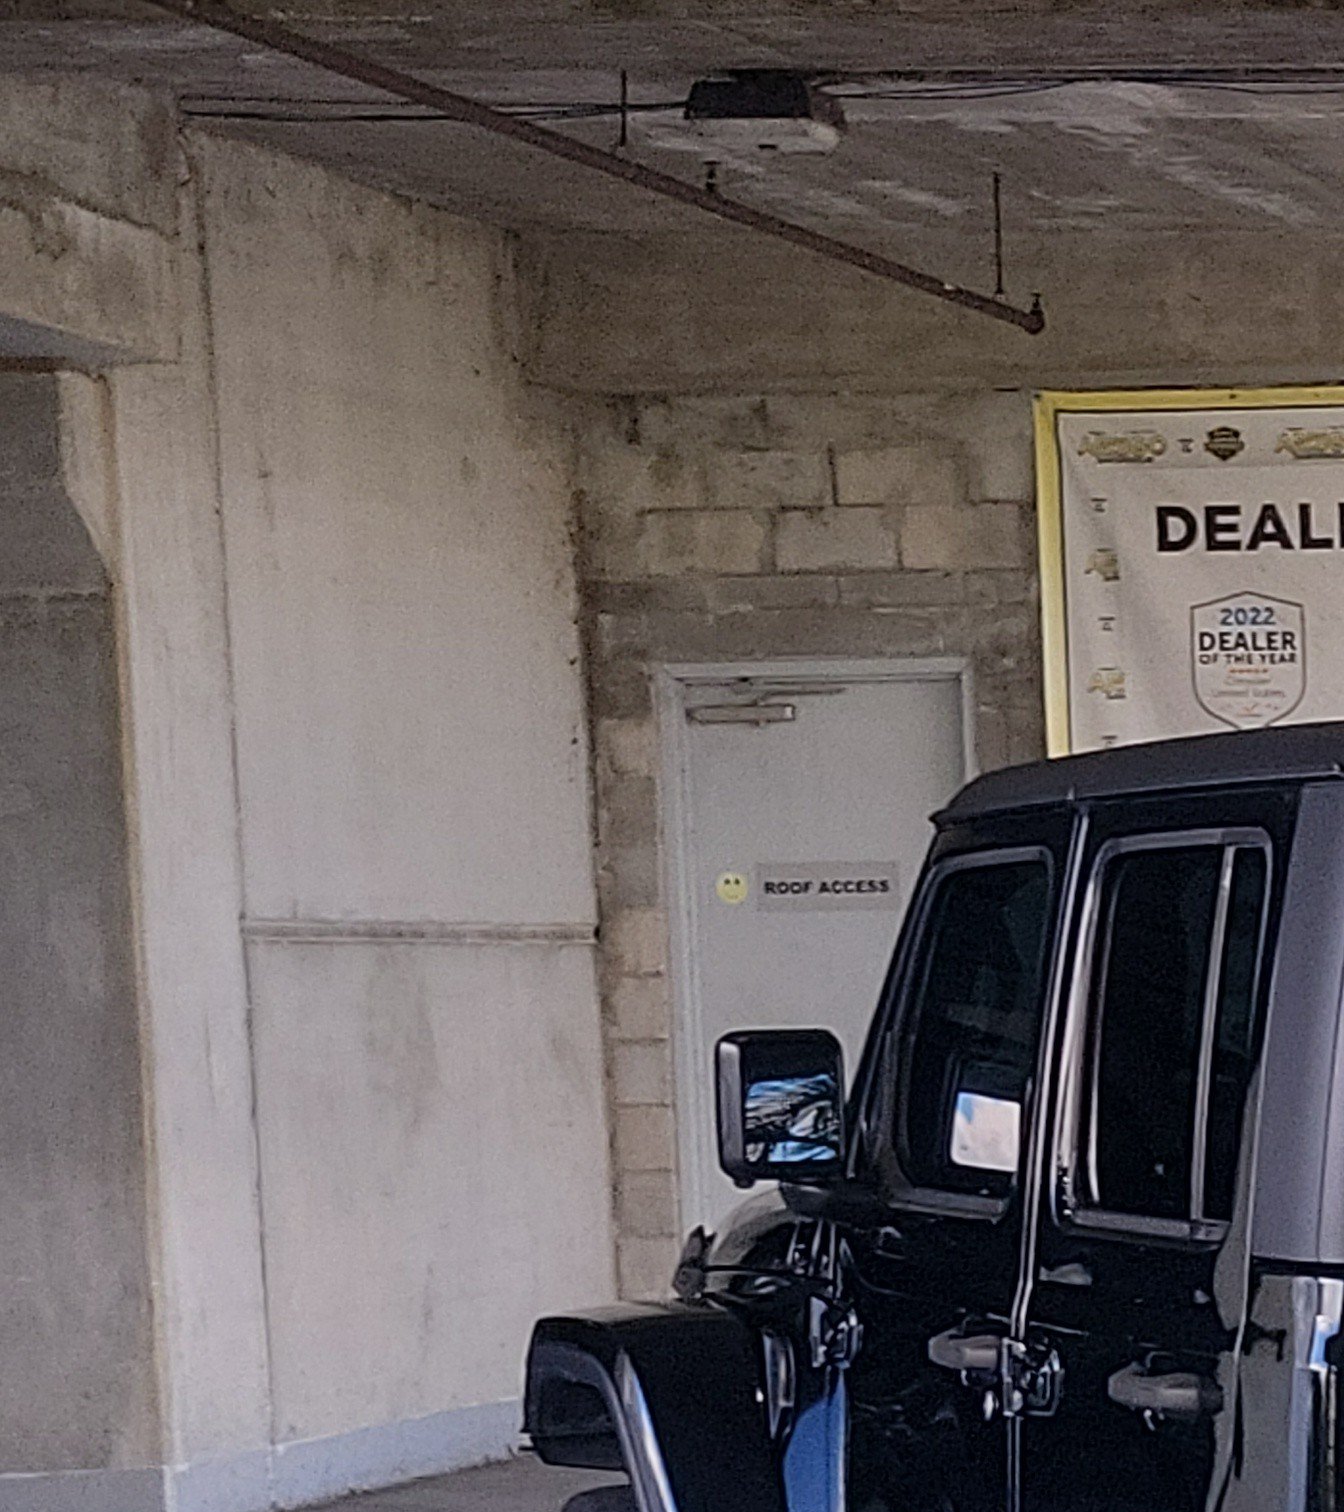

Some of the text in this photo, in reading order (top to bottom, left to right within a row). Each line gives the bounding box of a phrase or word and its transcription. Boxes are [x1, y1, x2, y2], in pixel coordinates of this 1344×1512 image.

[1220, 607, 1276, 626] 2022
[1199, 631, 1297, 651] DEALER
[1199, 653, 1297, 665] OF THE YEAR
[764, 879, 890, 894] ROOF ACCESS
